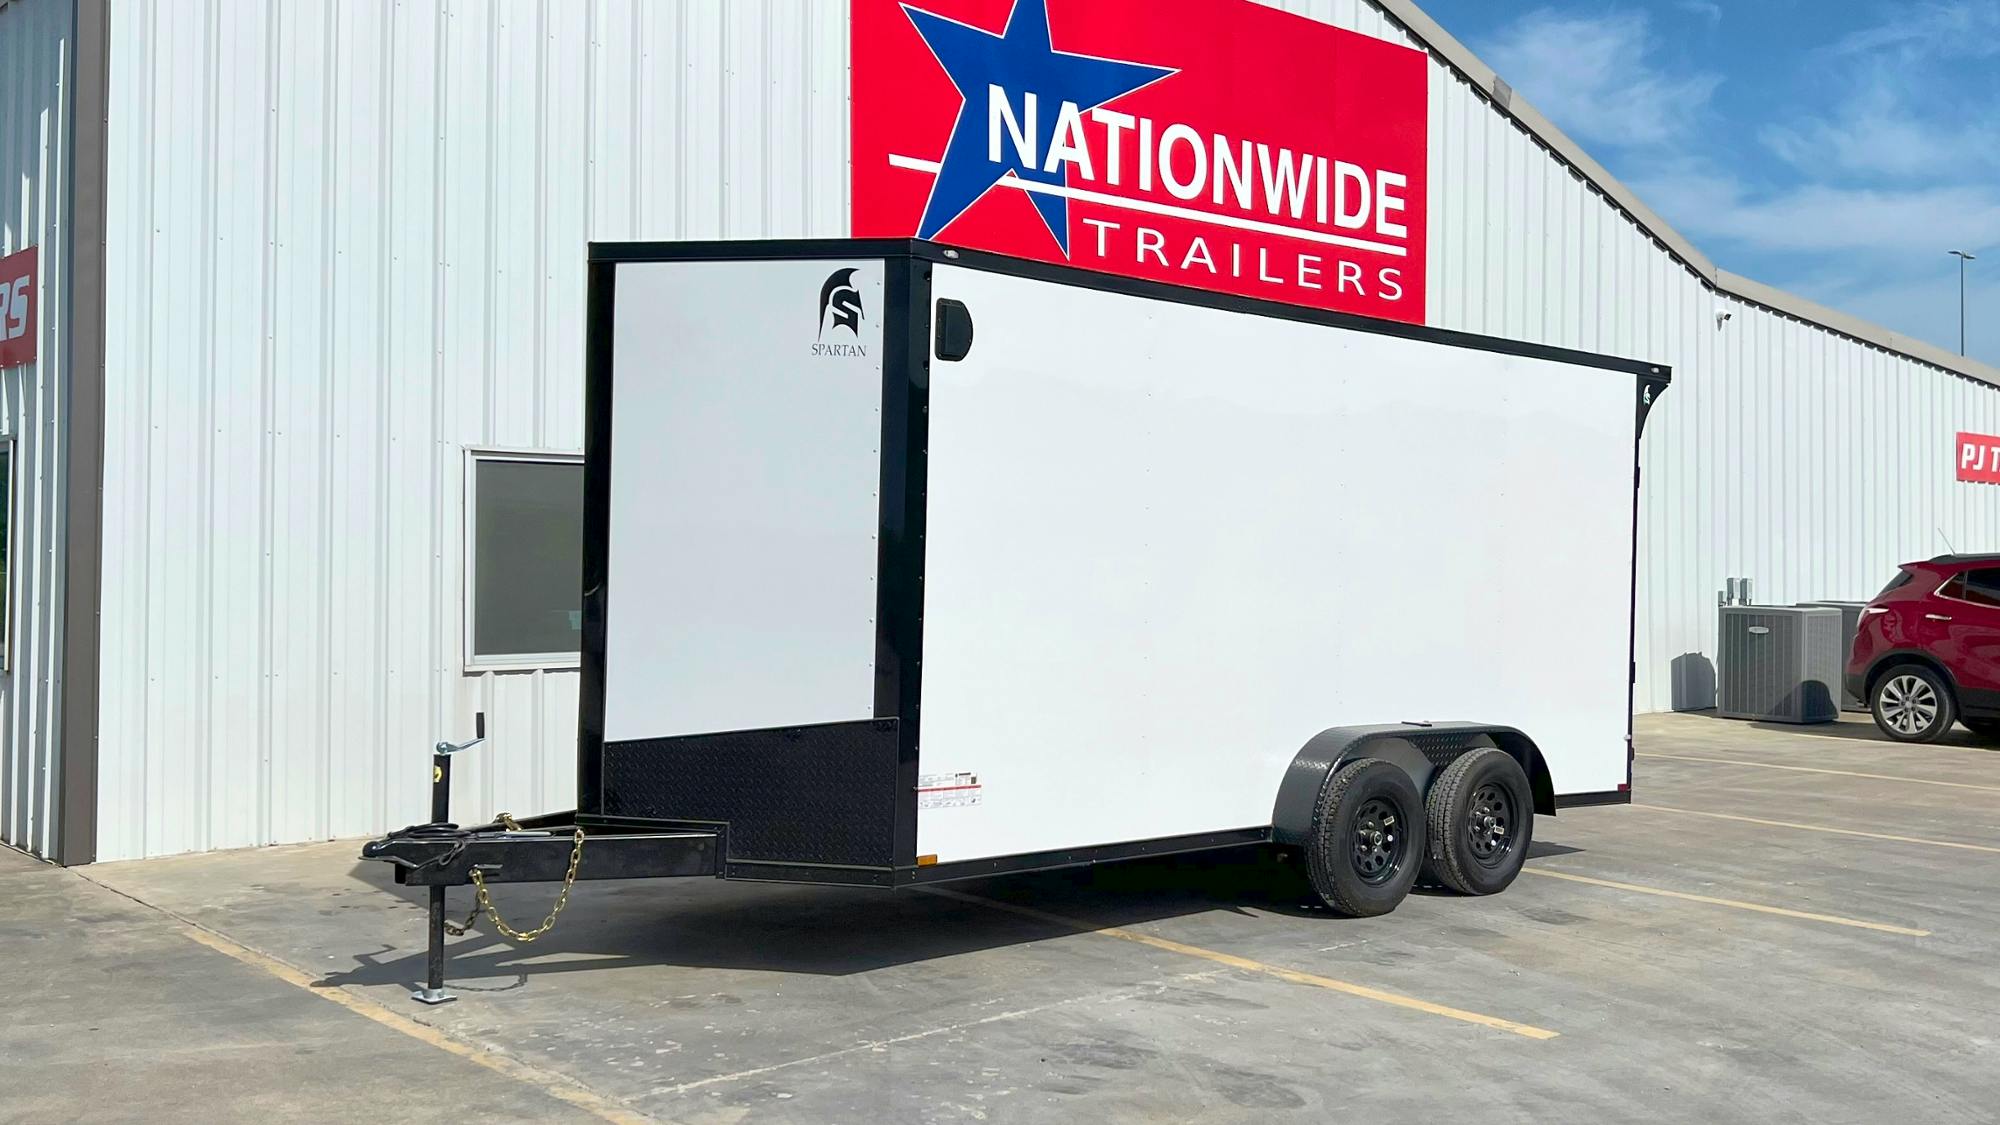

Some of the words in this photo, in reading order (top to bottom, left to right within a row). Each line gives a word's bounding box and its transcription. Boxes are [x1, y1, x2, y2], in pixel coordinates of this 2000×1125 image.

[988, 83, 1408, 239] NATIONWIDE
[1083, 217, 1403, 300] TRAILERS
[811, 343, 867, 357] SPARTAN
[1961, 443, 1985, 471] PJ
